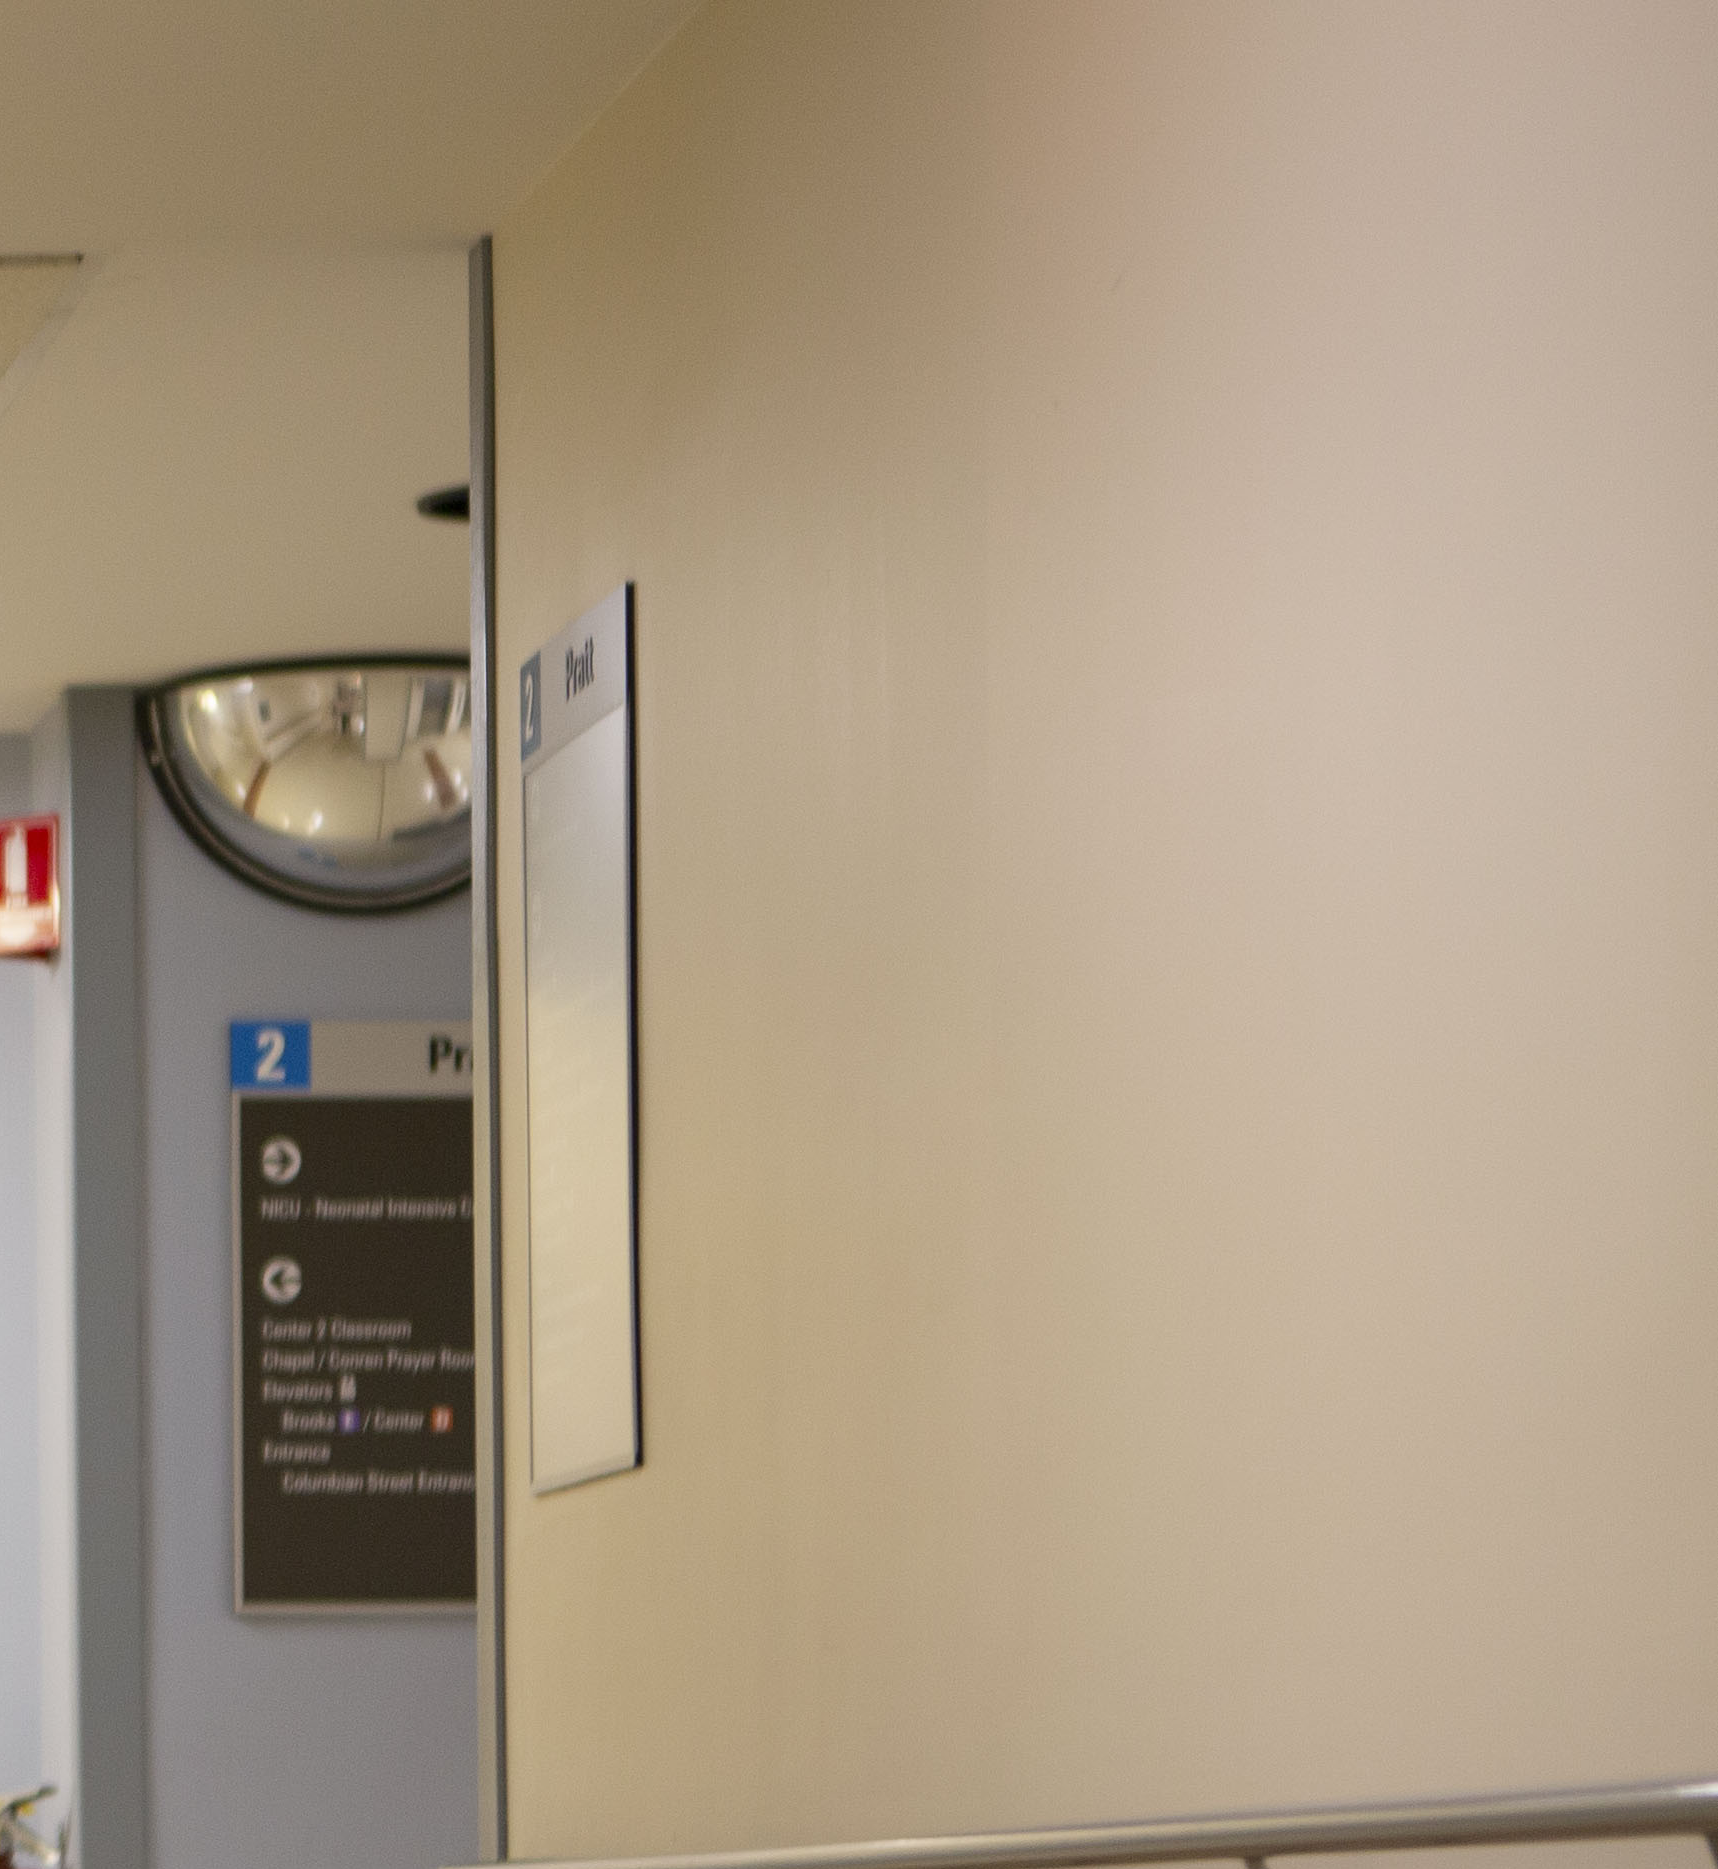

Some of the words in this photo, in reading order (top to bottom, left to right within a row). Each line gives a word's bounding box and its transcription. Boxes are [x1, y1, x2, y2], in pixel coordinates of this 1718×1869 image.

[524, 673, 535, 742] 2
[256, 1027, 287, 1083] 2
[428, 1034, 473, 1074] Pr
